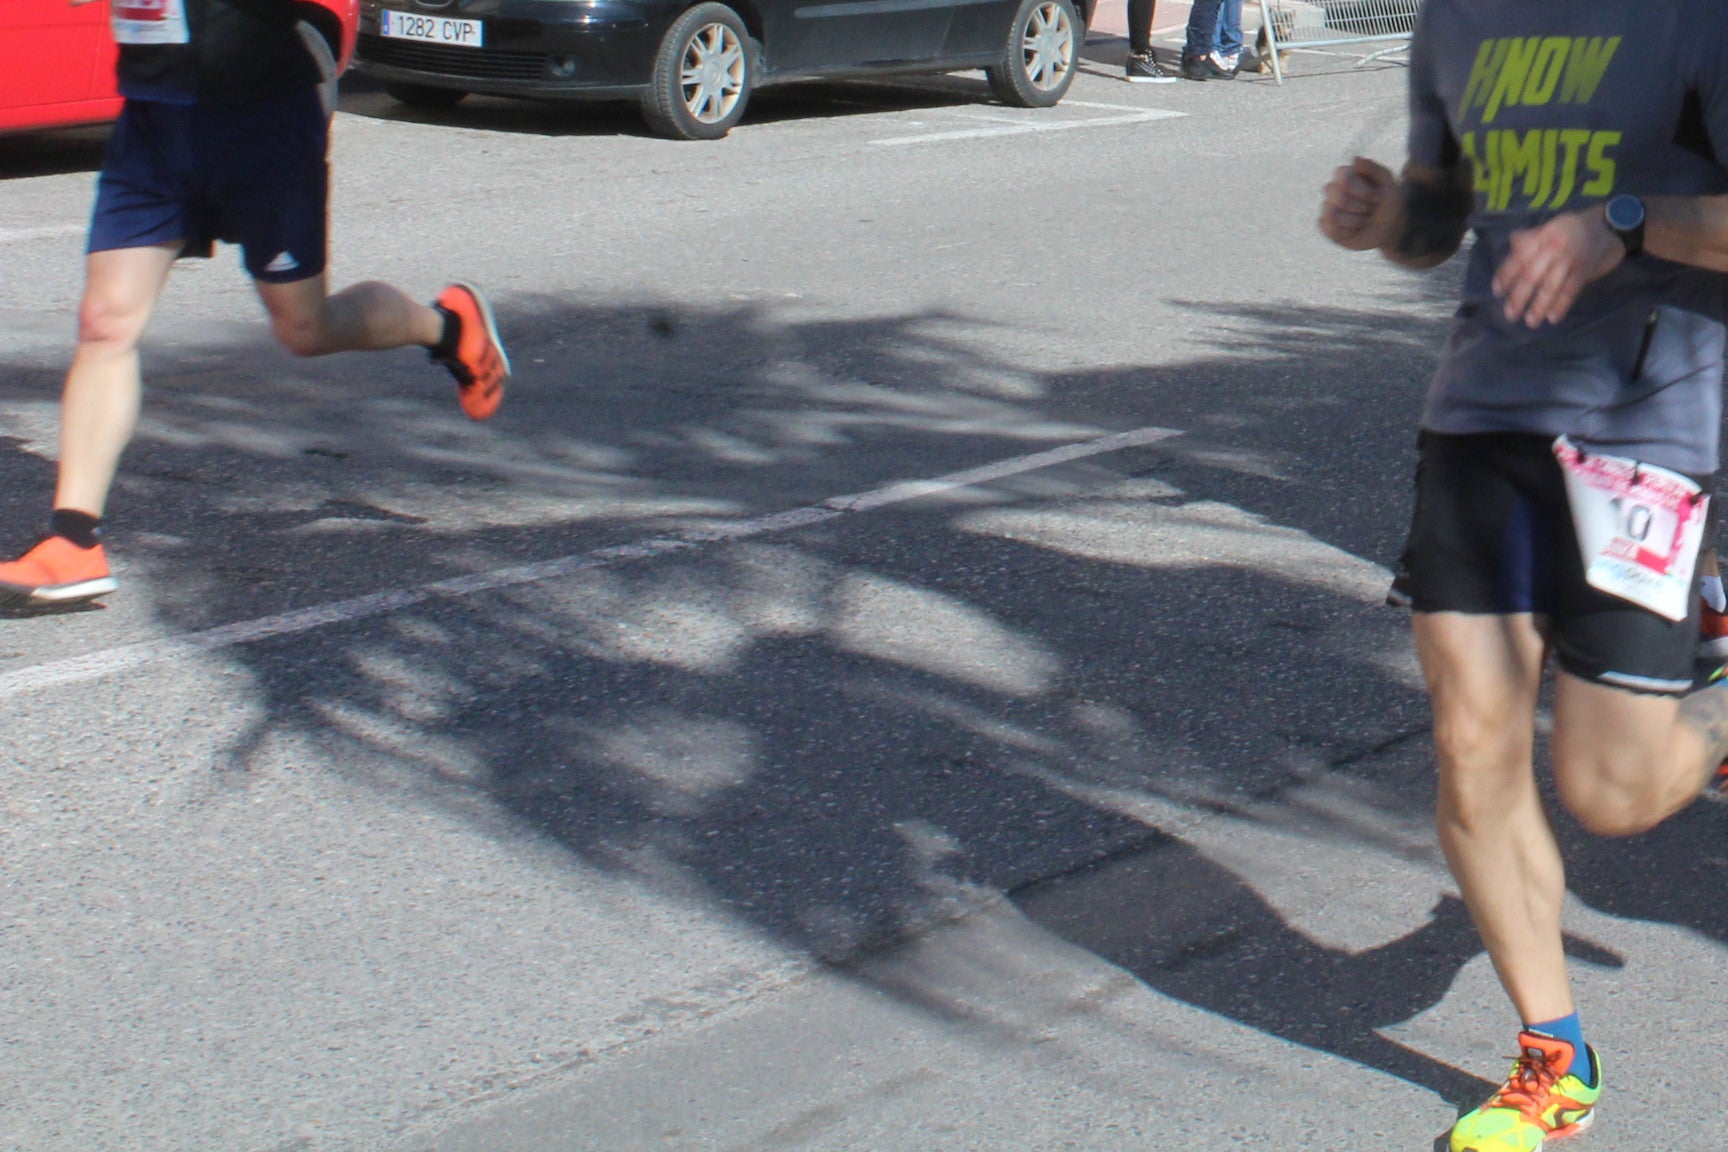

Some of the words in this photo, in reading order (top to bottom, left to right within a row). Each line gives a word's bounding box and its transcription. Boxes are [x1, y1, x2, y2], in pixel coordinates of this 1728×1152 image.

[398, 15, 435, 39] 1282
[442, 21, 474, 43] CVP
[1461, 128, 1623, 212] LIMITS
